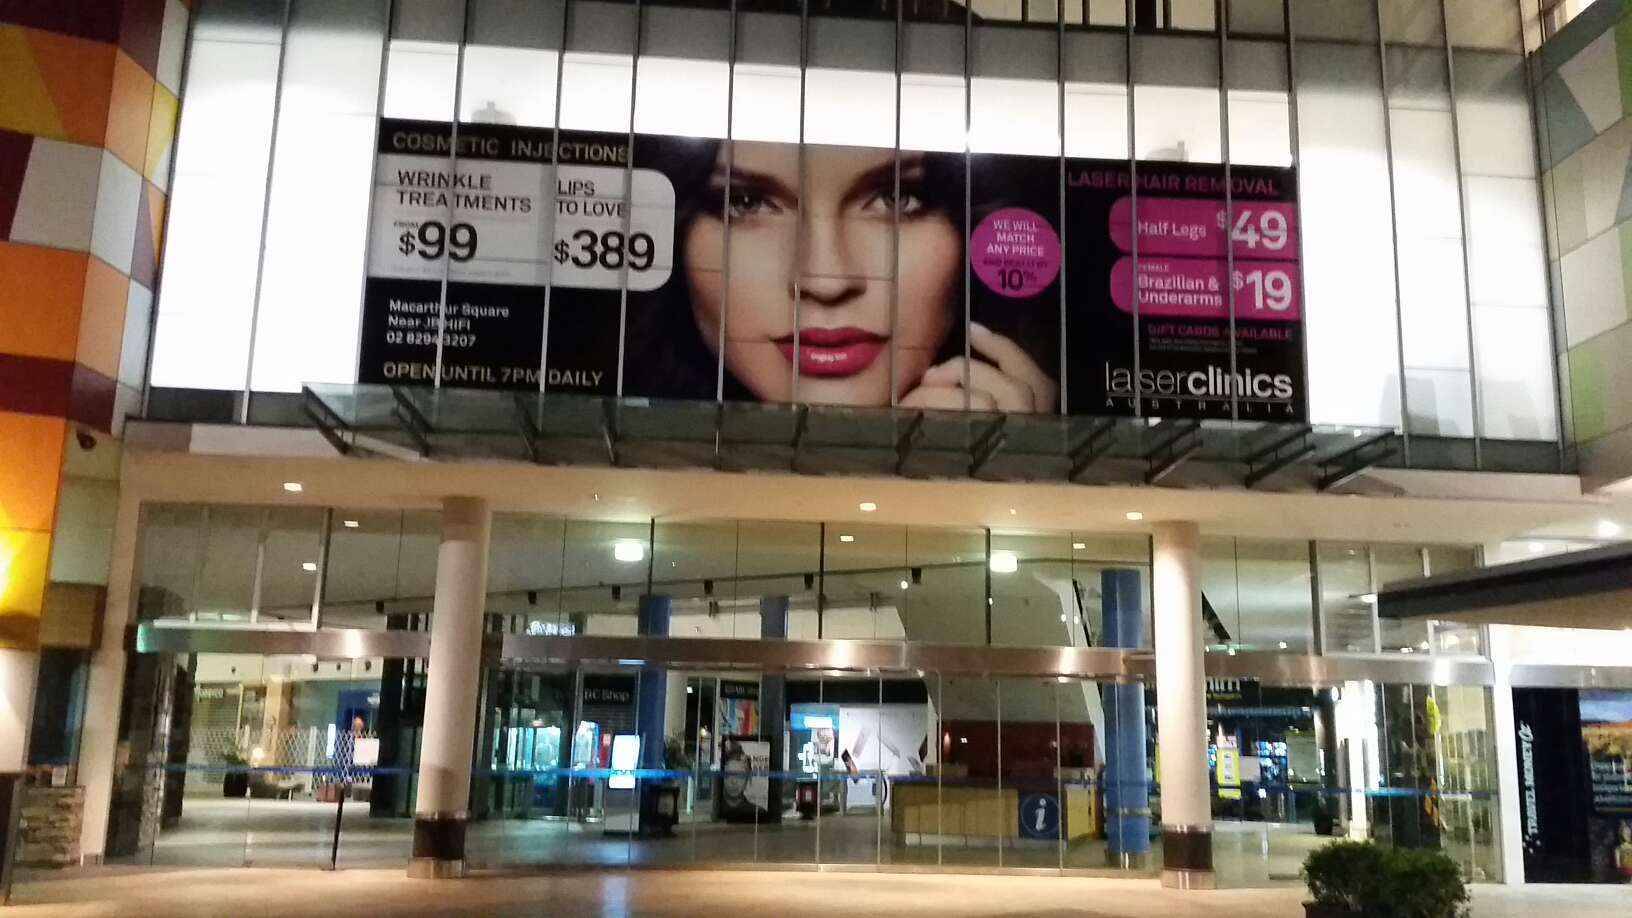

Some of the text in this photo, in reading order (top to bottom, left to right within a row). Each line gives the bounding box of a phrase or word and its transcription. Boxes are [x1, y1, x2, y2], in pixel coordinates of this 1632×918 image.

[392, 131, 629, 163] COSMETIC INJECTIONS
[398, 170, 492, 190] WRINKLE
[558, 179, 595, 197] LIPS
[1068, 171, 1278, 196] LASER HAIR REMOVAL
[397, 189, 531, 213] TREATMENTS
[557, 200, 627, 218] TO LOVE
[993, 220, 1038, 233] WE WILL
[1138, 221, 1206, 241] Half Legs
[1216, 209, 1288, 251] $49
[398, 220, 478, 262] $99
[996, 232, 1035, 244] MATCH
[554, 229, 655, 272] $389
[986, 243, 1044, 257] ANY PRICE
[1138, 273, 1219, 291] Brazilian &
[1232, 269, 1292, 311] $19
[1138, 290, 1222, 307] Underarms
[462, 302, 509, 319] Square
[388, 314, 420, 328] Near
[386, 330, 403, 344] 02
[383, 361, 602, 387] OPEN UNTIL 7PM DAILY
[1105, 361, 1293, 399] laserclinics
